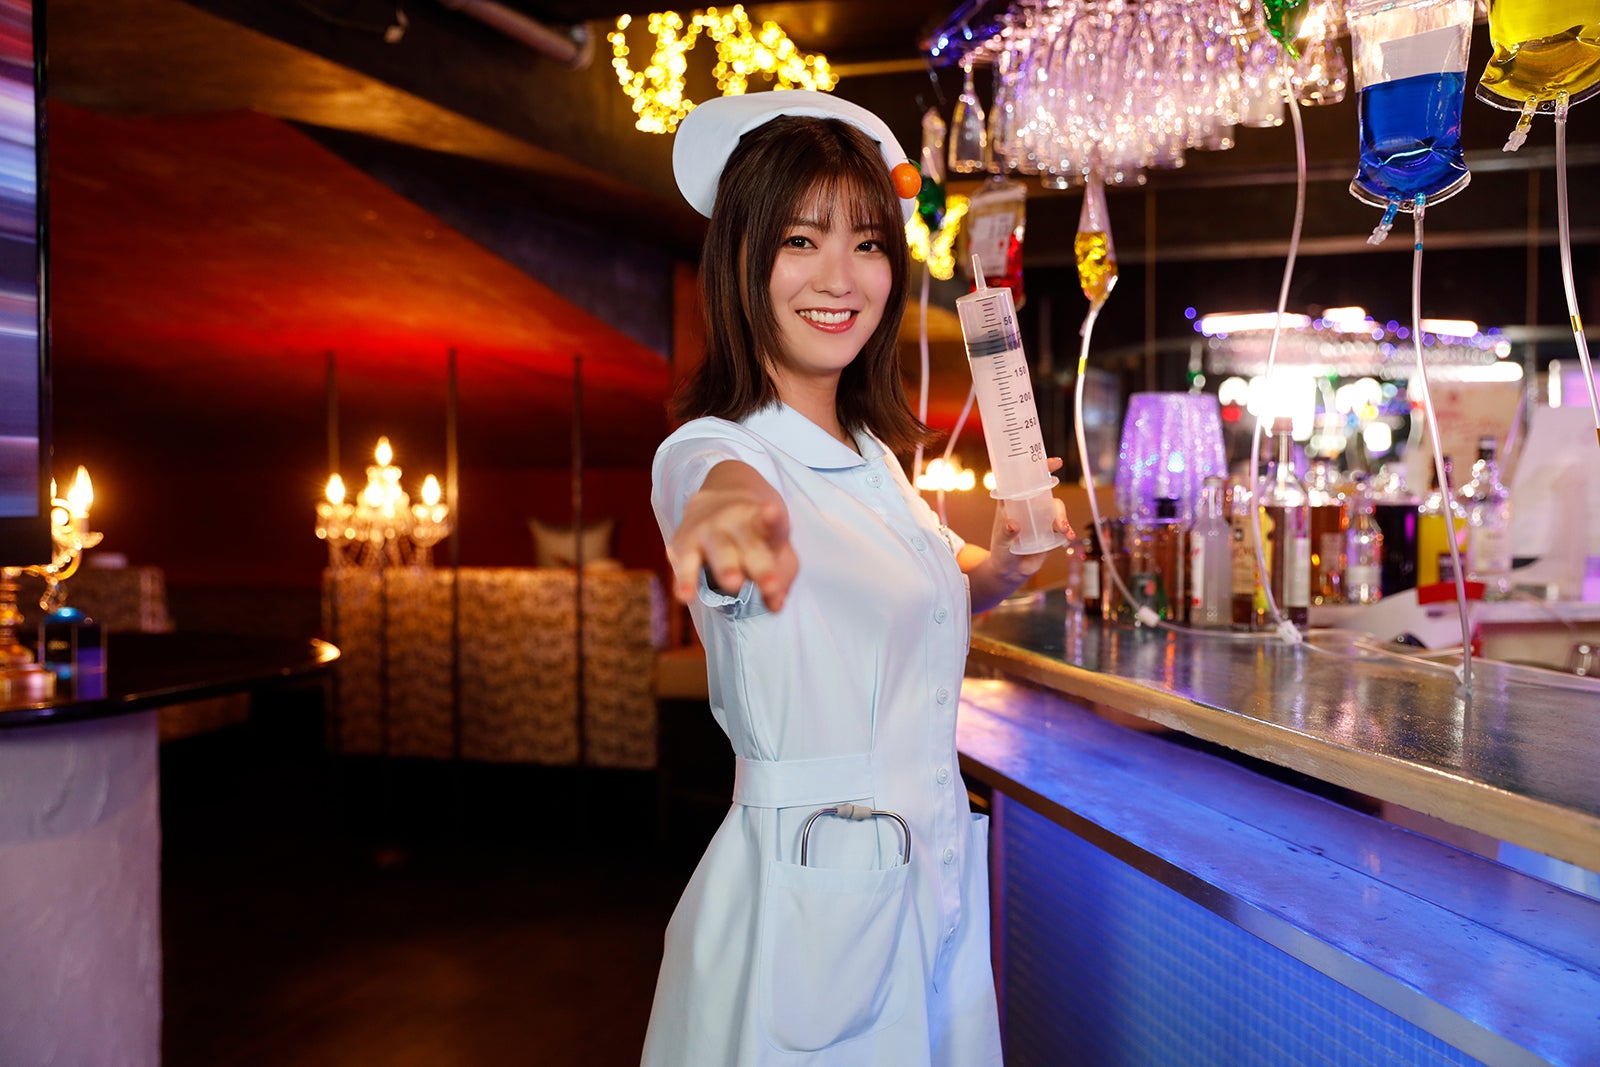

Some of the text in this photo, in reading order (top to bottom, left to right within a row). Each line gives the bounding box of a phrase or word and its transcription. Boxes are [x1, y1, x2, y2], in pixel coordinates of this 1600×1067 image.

[1003, 315, 1012, 326] 50
[1014, 366, 1026, 377] 150
[1019, 392, 1031, 403] 200
[1024, 416, 1036, 429] 250
[1029, 443, 1041, 454] 300
